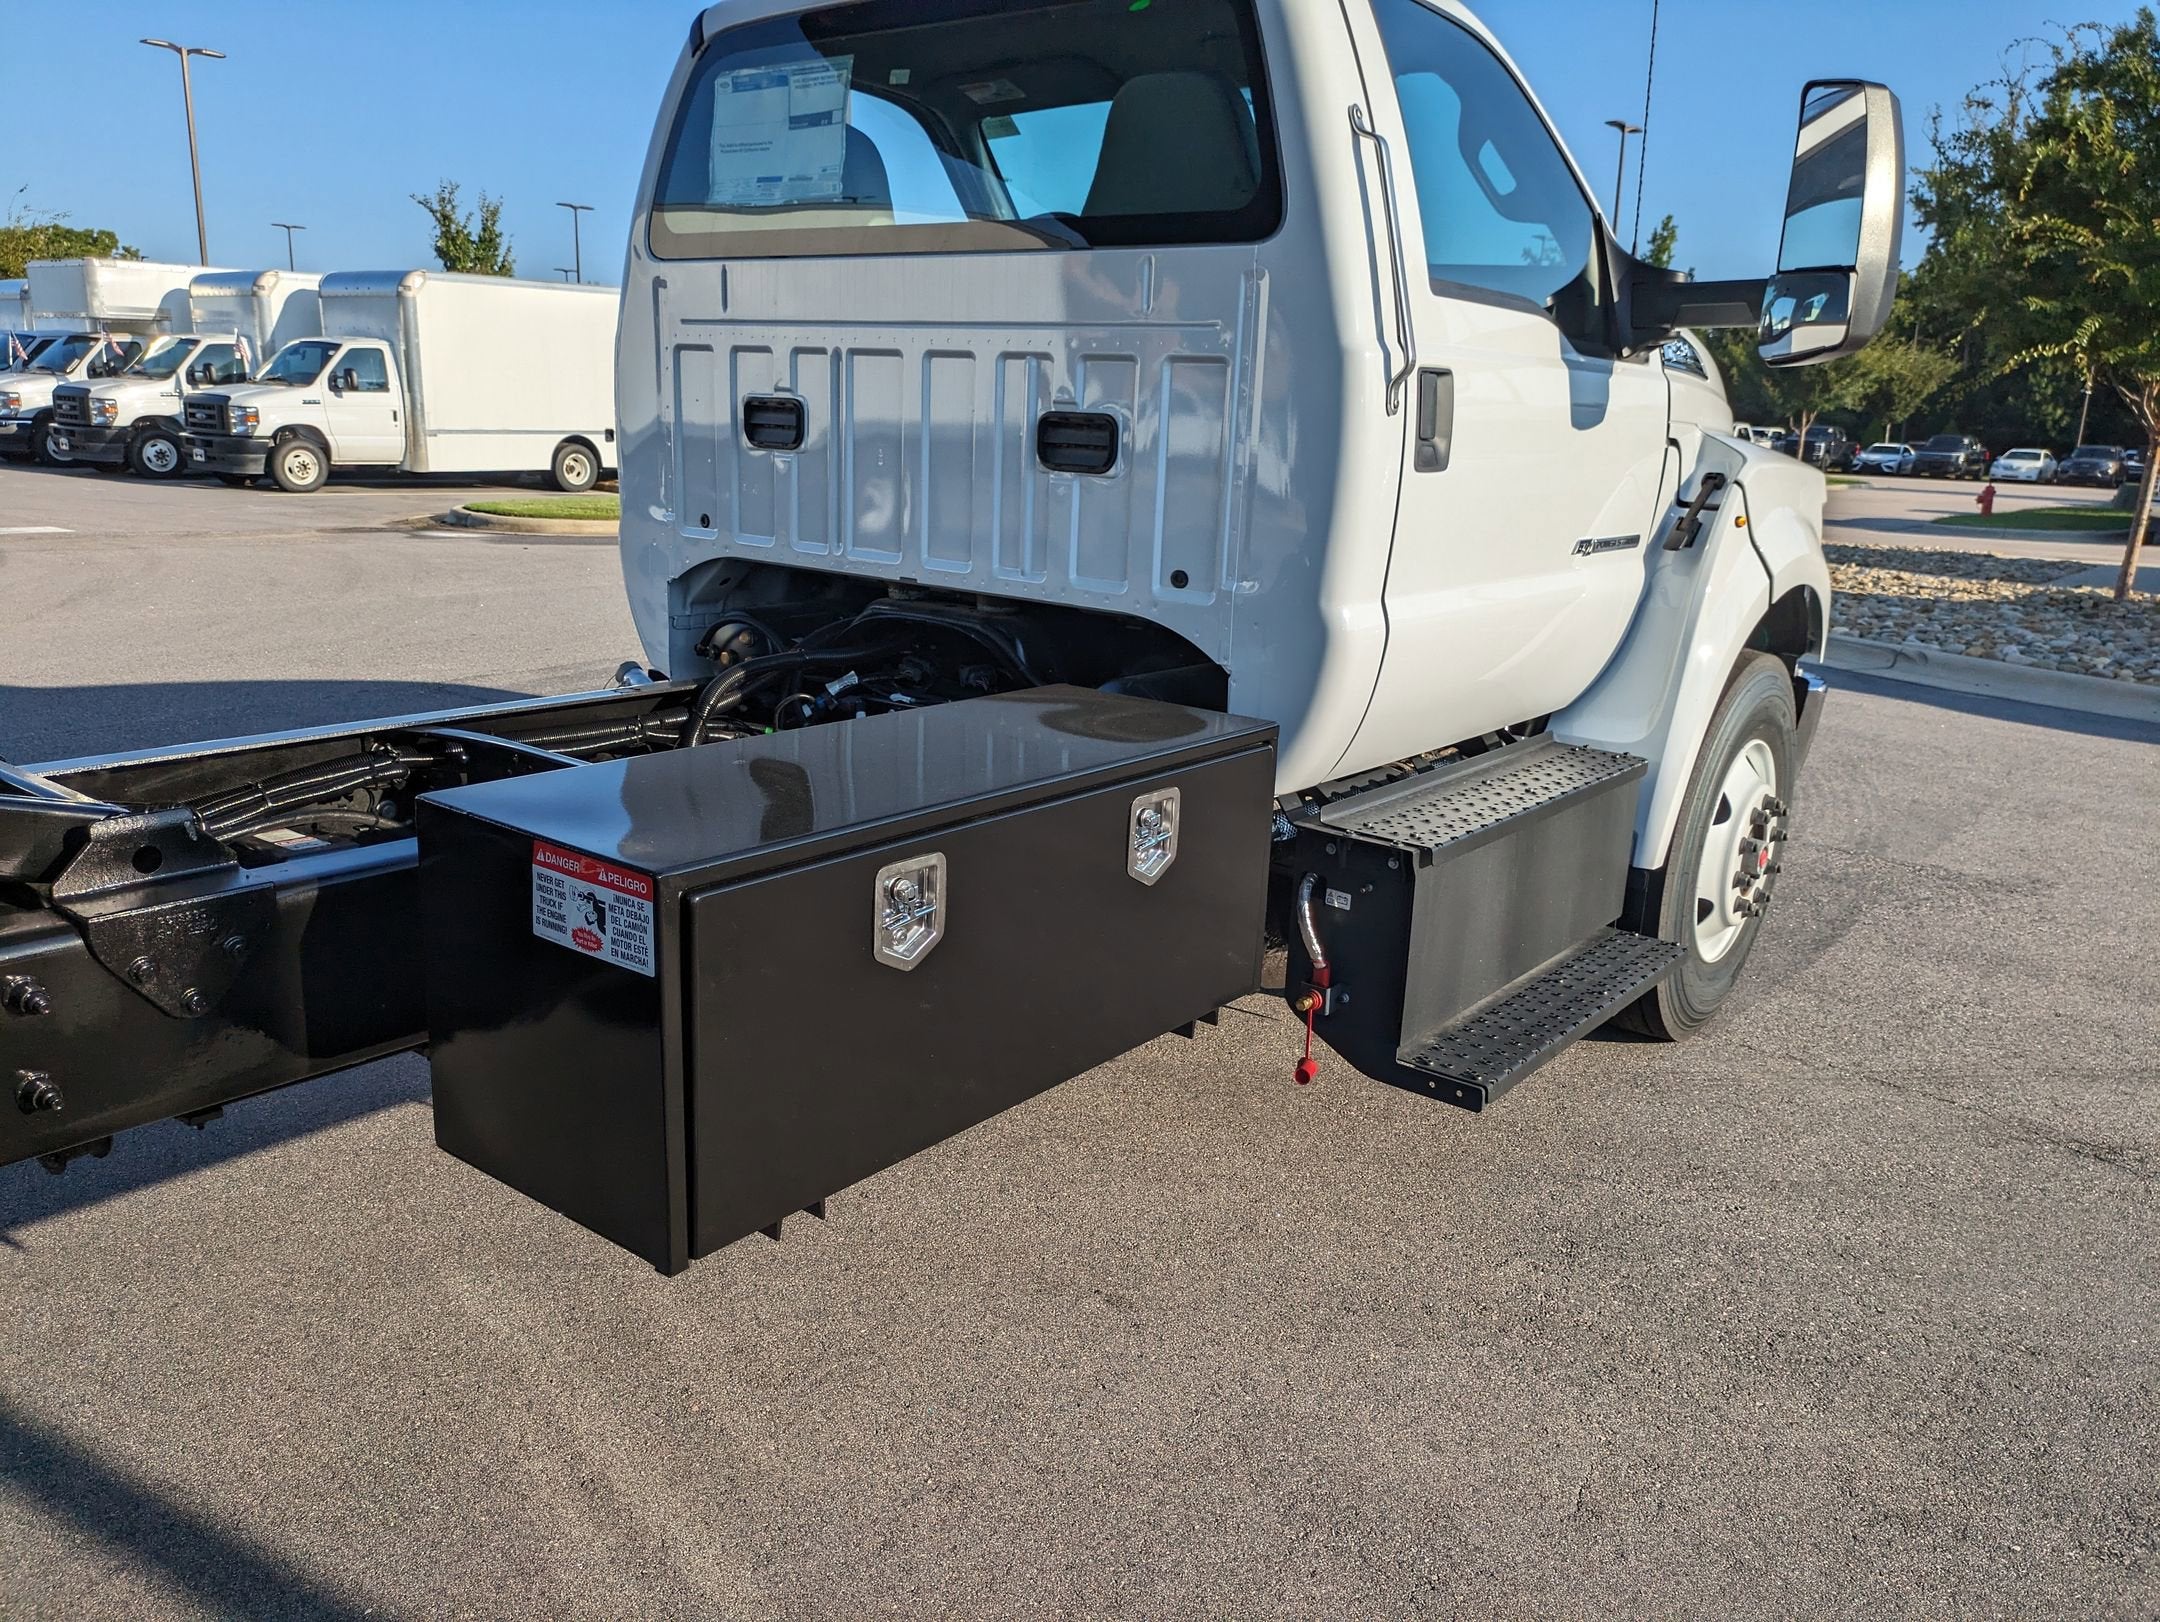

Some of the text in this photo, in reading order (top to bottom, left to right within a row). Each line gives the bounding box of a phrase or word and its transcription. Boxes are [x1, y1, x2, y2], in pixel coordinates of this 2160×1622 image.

[545, 852, 580, 873] DANGER
[536, 872, 565, 889] NEVER GET
[608, 872, 647, 894] PELIGRO
[536, 882, 567, 901] UNDER THIS
[539, 894, 564, 911] TRUCK IF
[636, 901, 645, 912] SE
[536, 904, 567, 924] THE ENGINE
[608, 903, 650, 925] META DEBAJO
[535, 915, 568, 935] IS RUNNING!
[610, 915, 648, 935] DEL CAMIÓN
[612, 926, 646, 946] CUANDO EL
[610, 936, 649, 957] MOTOR ESTÉ
[610, 947, 619, 959] EN
[620, 950, 649, 968] MARCHA!
